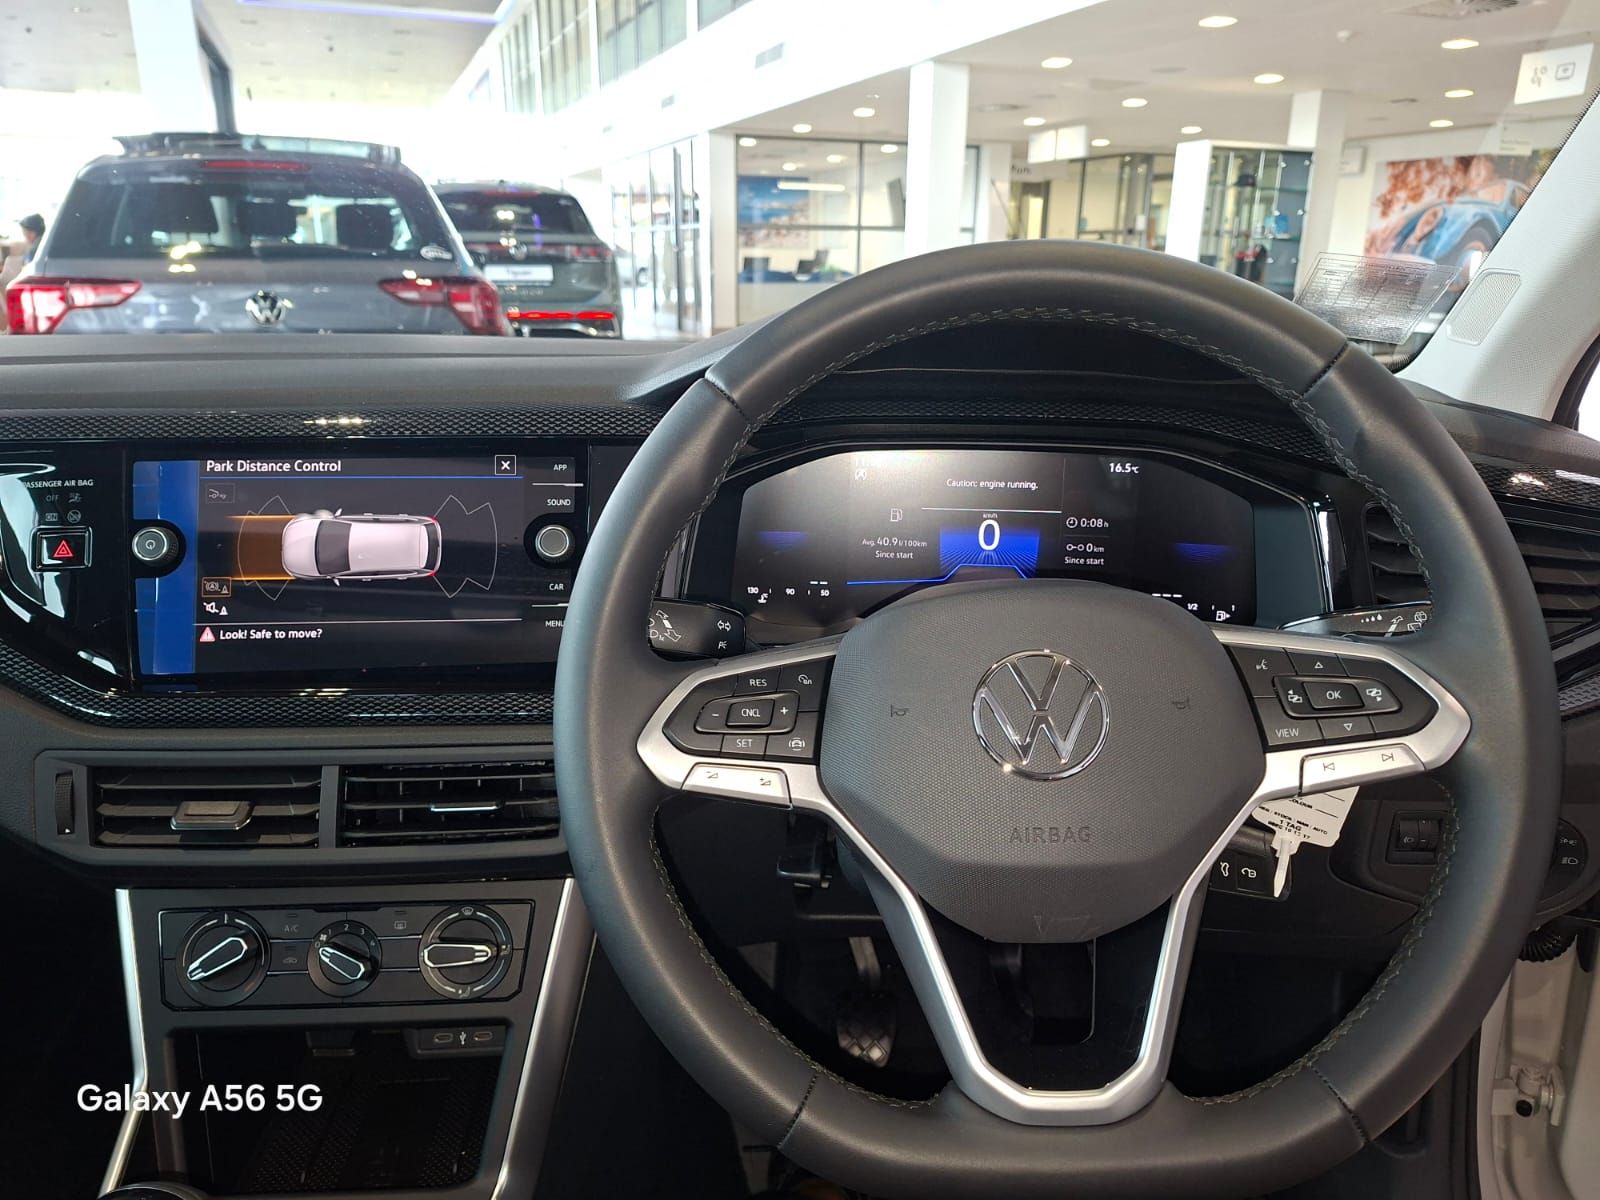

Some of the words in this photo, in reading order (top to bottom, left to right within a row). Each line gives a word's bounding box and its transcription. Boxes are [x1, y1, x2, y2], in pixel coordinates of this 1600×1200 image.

[206, 460, 234, 472] Park
[237, 460, 291, 472] Distance
[294, 460, 342, 472] Control
[946, 478, 978, 488] Caution:
[979, 480, 1005, 490] engine
[1007, 481, 1039, 490] running.
[978, 519, 1001, 551] 0
[875, 551, 895, 560] Since
[896, 552, 914, 560] start
[1064, 556, 1085, 564] Since
[1086, 557, 1104, 565] start
[821, 589, 830, 597] 50
[220, 630, 247, 640] Look!
[250, 629, 272, 639] Safe
[274, 630, 286, 638] to
[288, 629, 323, 639] move?
[749, 679, 768, 687] RES
[1326, 690, 1342, 700] OK
[741, 708, 761, 718] CNCL
[1275, 728, 1299, 738] VIEW
[736, 739, 753, 748] SET
[1009, 826, 1091, 843] AIRBAG
[360, 927, 366, 935] 3
